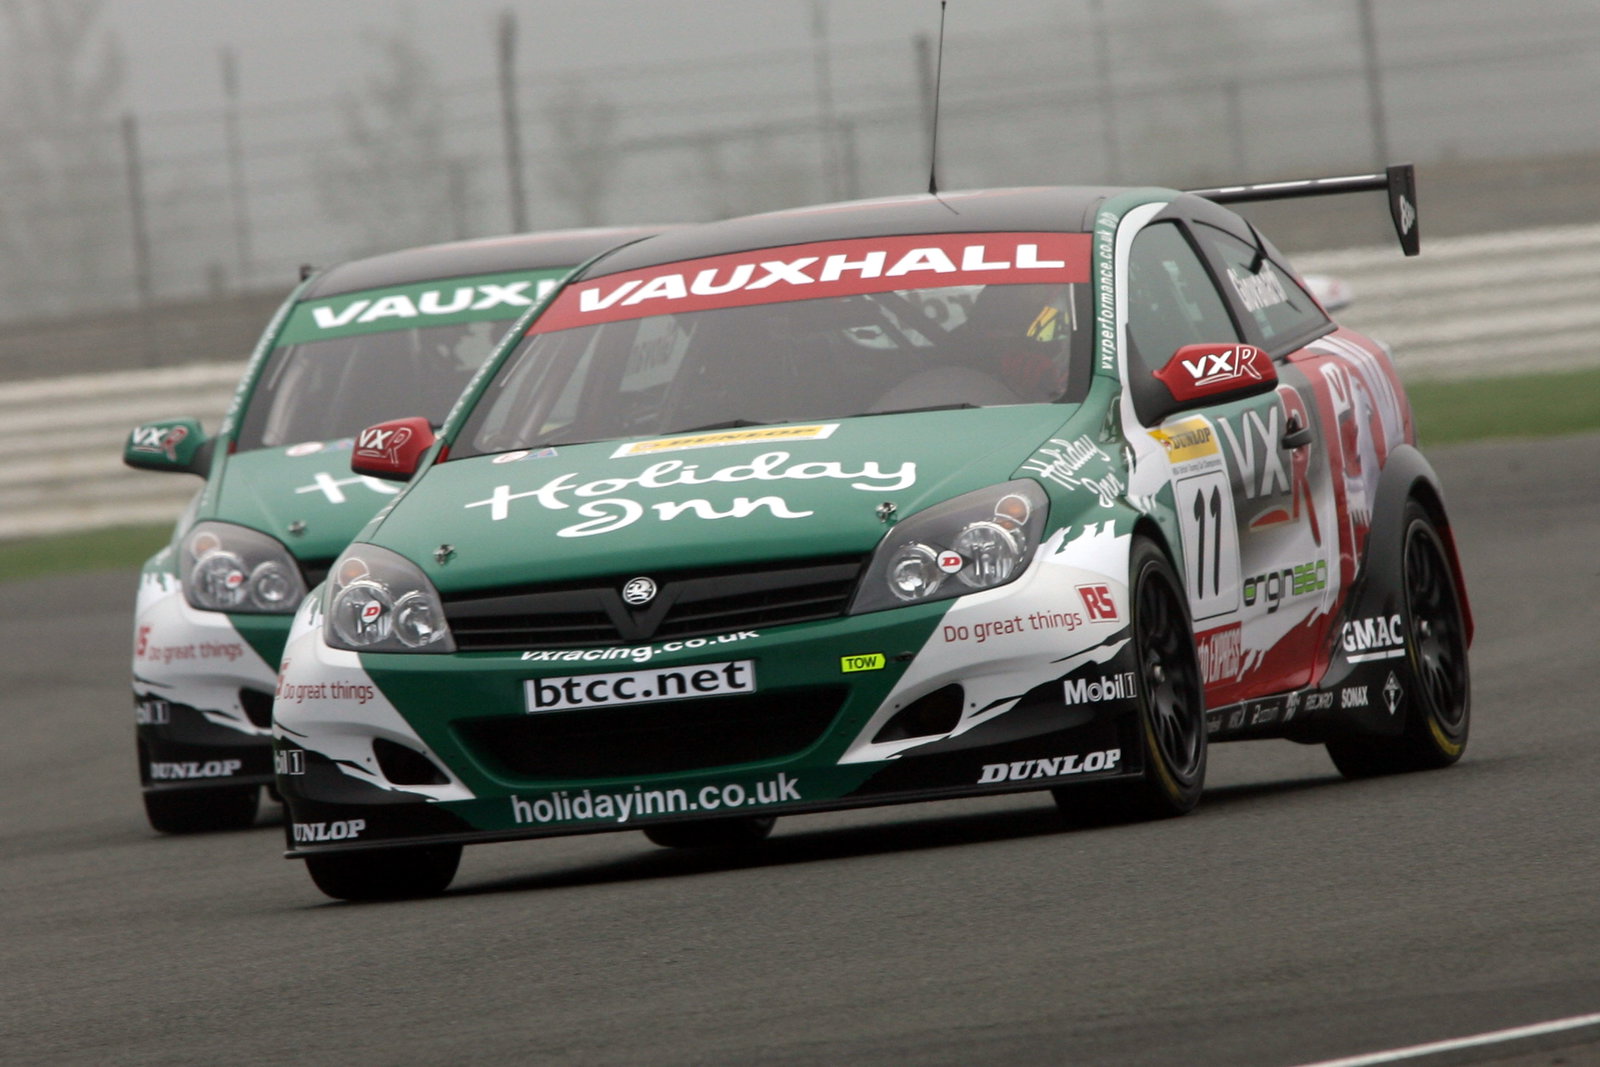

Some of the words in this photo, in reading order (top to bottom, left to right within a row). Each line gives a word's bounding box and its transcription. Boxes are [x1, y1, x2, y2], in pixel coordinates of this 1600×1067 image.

[579, 244, 1065, 312] VAUXHALL
[1182, 346, 1262, 381] VXR
[132, 425, 188, 461] VXR
[358, 427, 412, 465] VXR
[1168, 427, 1210, 449] DUNLOP
[1021, 434, 1111, 491] Holiday
[1217, 384, 1321, 547] VXR
[465, 452, 917, 521] Holiday
[1081, 472, 1125, 508] Inn
[557, 496, 814, 538] Inn
[1194, 484, 1222, 600] 11
[1078, 585, 1118, 621] RS
[943, 625, 969, 643] Do
[974, 615, 1024, 643] great
[1028, 609, 1083, 632] things
[1343, 613, 1404, 652] GMAC
[163, 643, 196, 664] great
[201, 641, 244, 662] things
[520, 629, 760, 663] vxracing.co.uk
[845, 655, 877, 670] TOW
[297, 683, 326, 704] great
[331, 681, 375, 705] things
[534, 660, 747, 708] btcc.net
[1063, 672, 1125, 705] Mobil
[1341, 686, 1369, 709] SONAX
[977, 748, 1121, 784] DUNLOP
[511, 771, 801, 823] holidayinn.co.uk
